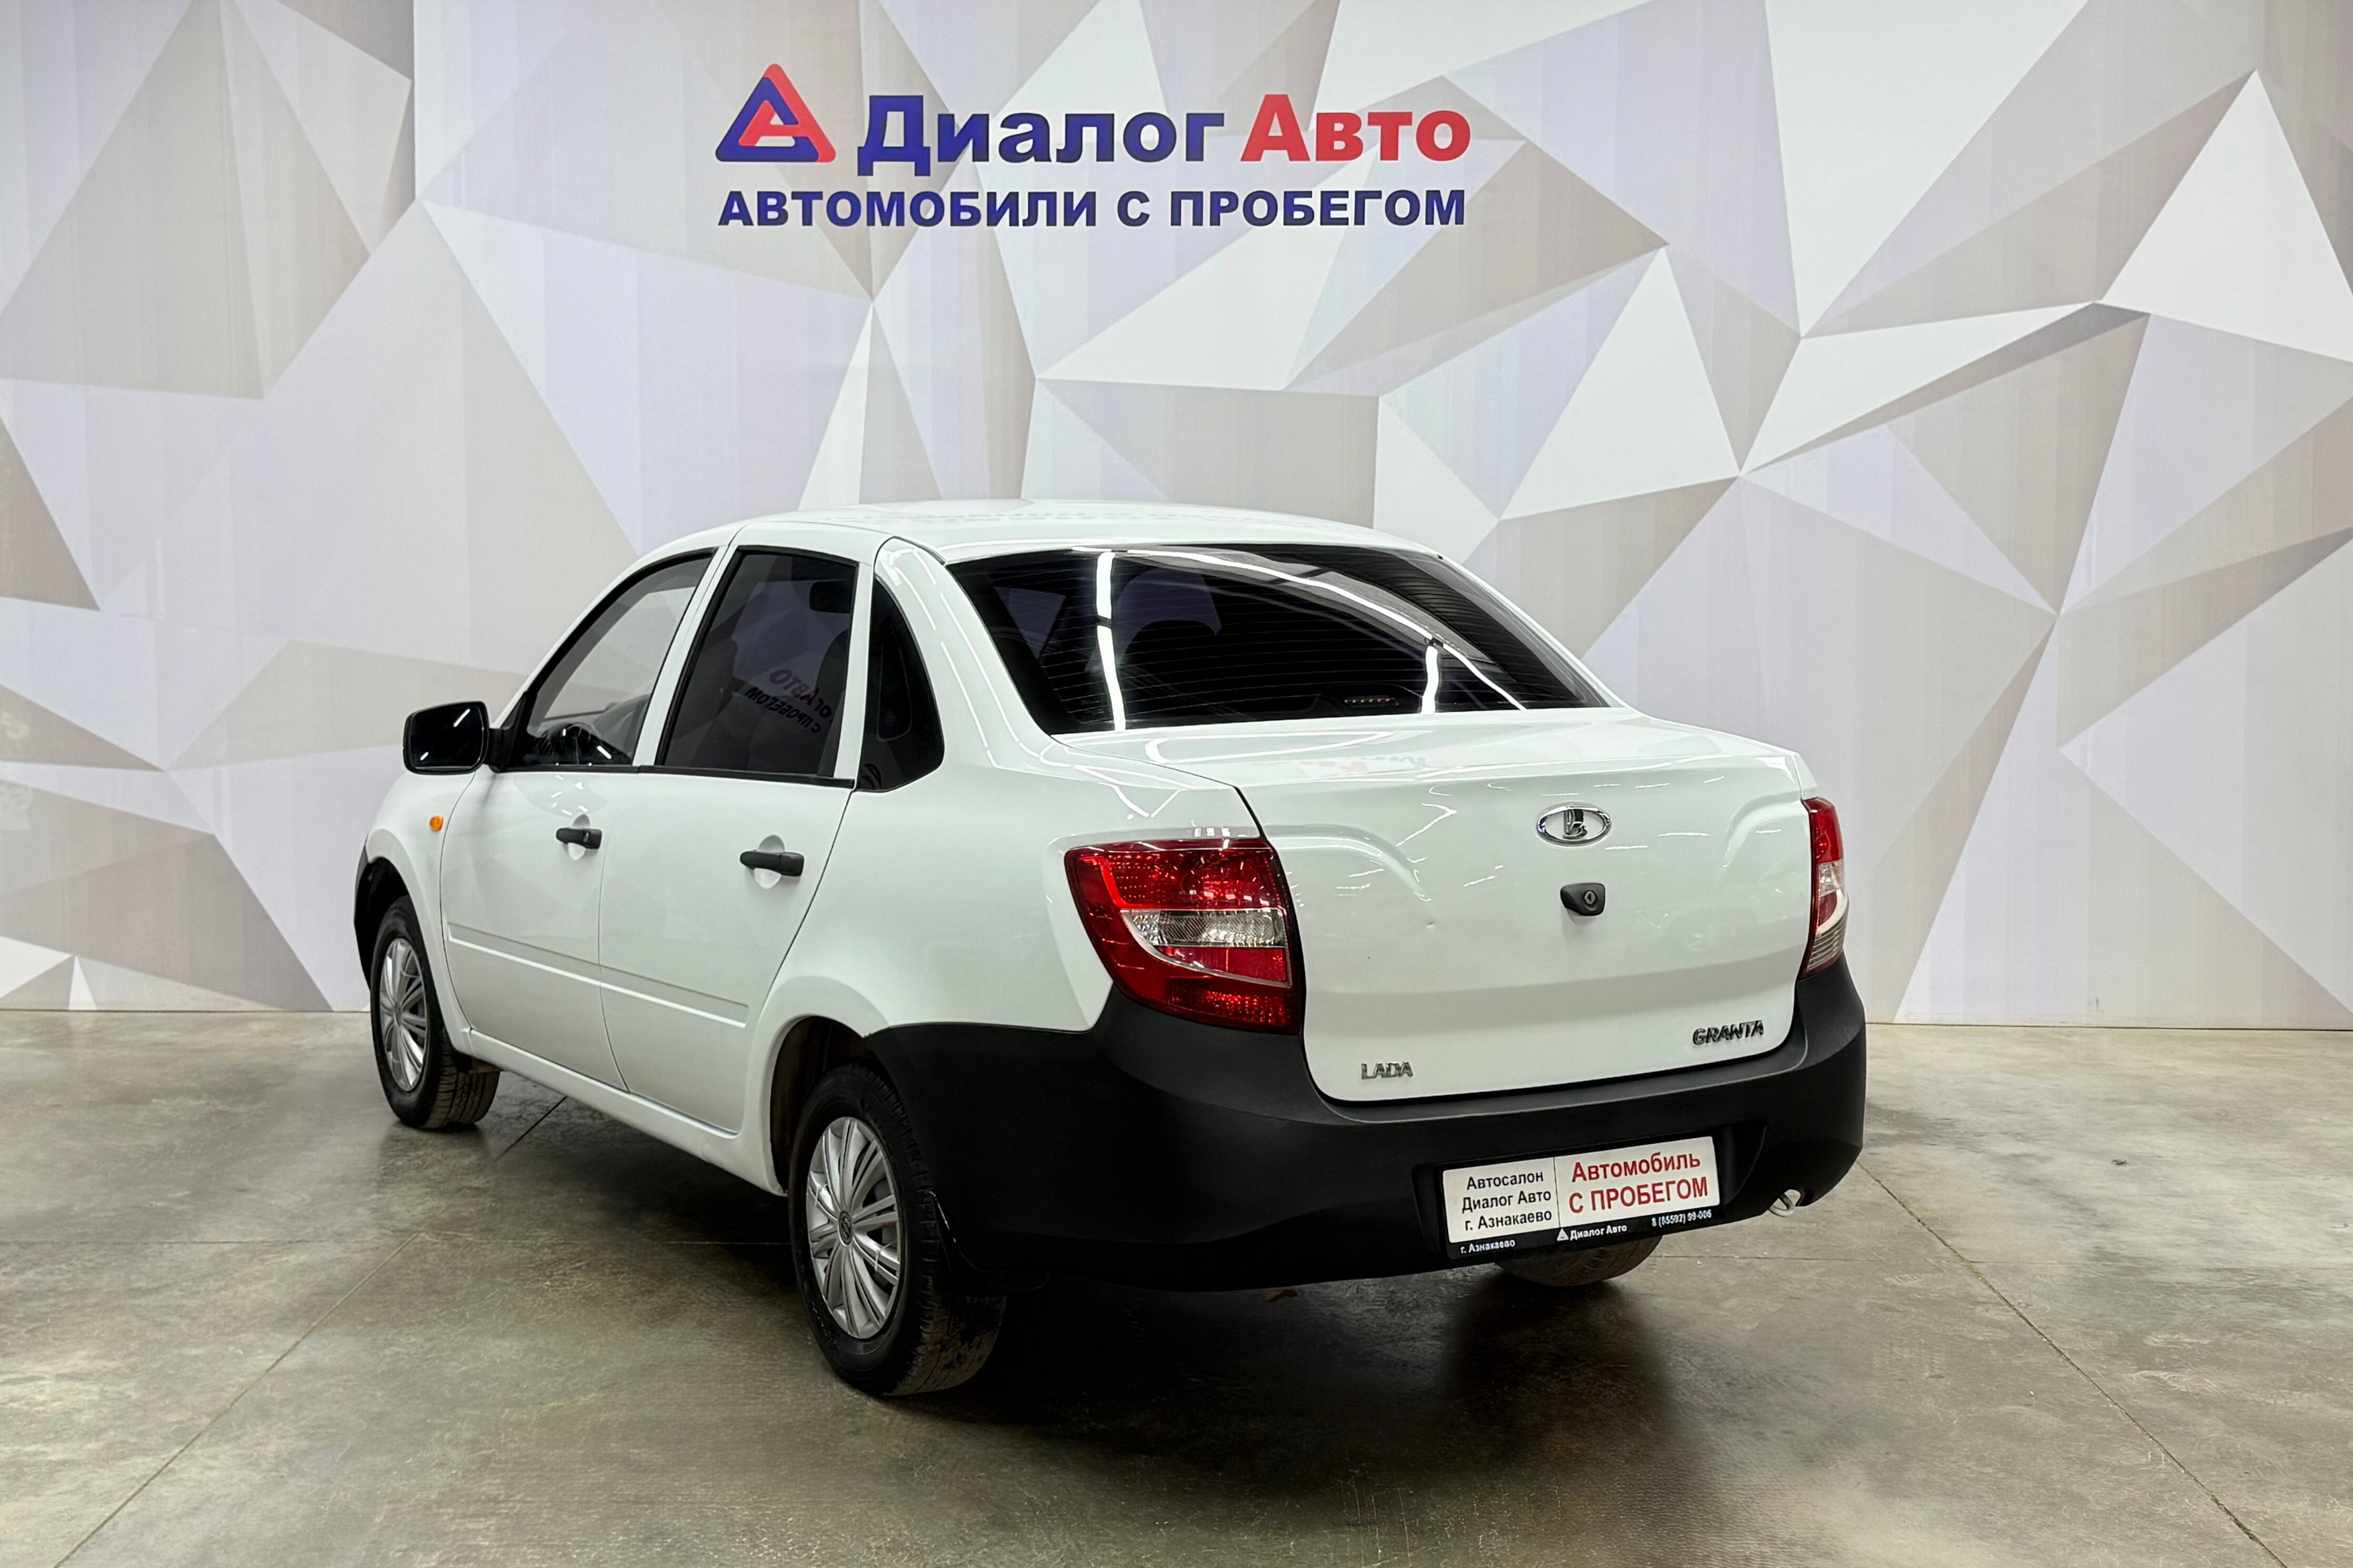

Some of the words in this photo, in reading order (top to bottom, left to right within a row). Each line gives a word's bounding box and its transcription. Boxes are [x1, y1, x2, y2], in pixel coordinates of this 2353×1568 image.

[858, 96, 1224, 176] Диалог
[1242, 95, 1471, 162] Авто
[719, 192, 1096, 226] АВТОМОБИЛИ
[1118, 191, 1149, 226] С
[1171, 190, 1464, 226] ПРОБЕГОМ
[1692, 1020, 1764, 1045] GRANTA
[1361, 1061, 1414, 1080] LADA
[1572, 1152, 1700, 1182] Автомобиль
[1467, 1172, 1543, 1190] Автосалон
[1462, 1195, 1514, 1214] Диалог
[1518, 1190, 1551, 1204] Авто
[1569, 1192, 1583, 1213] С
[1591, 1176, 1707, 1211] ПРОБЕГОМ
[1465, 1220, 1473, 1231] г.
[1478, 1211, 1552, 1229] Азнакаево
[1651, 1217, 1657, 1227] 8
[1570, 1228, 1604, 1241] Диалог
[1606, 1225, 1627, 1234] Авто
[1468, 1240, 1515, 1253] Азнакаево
